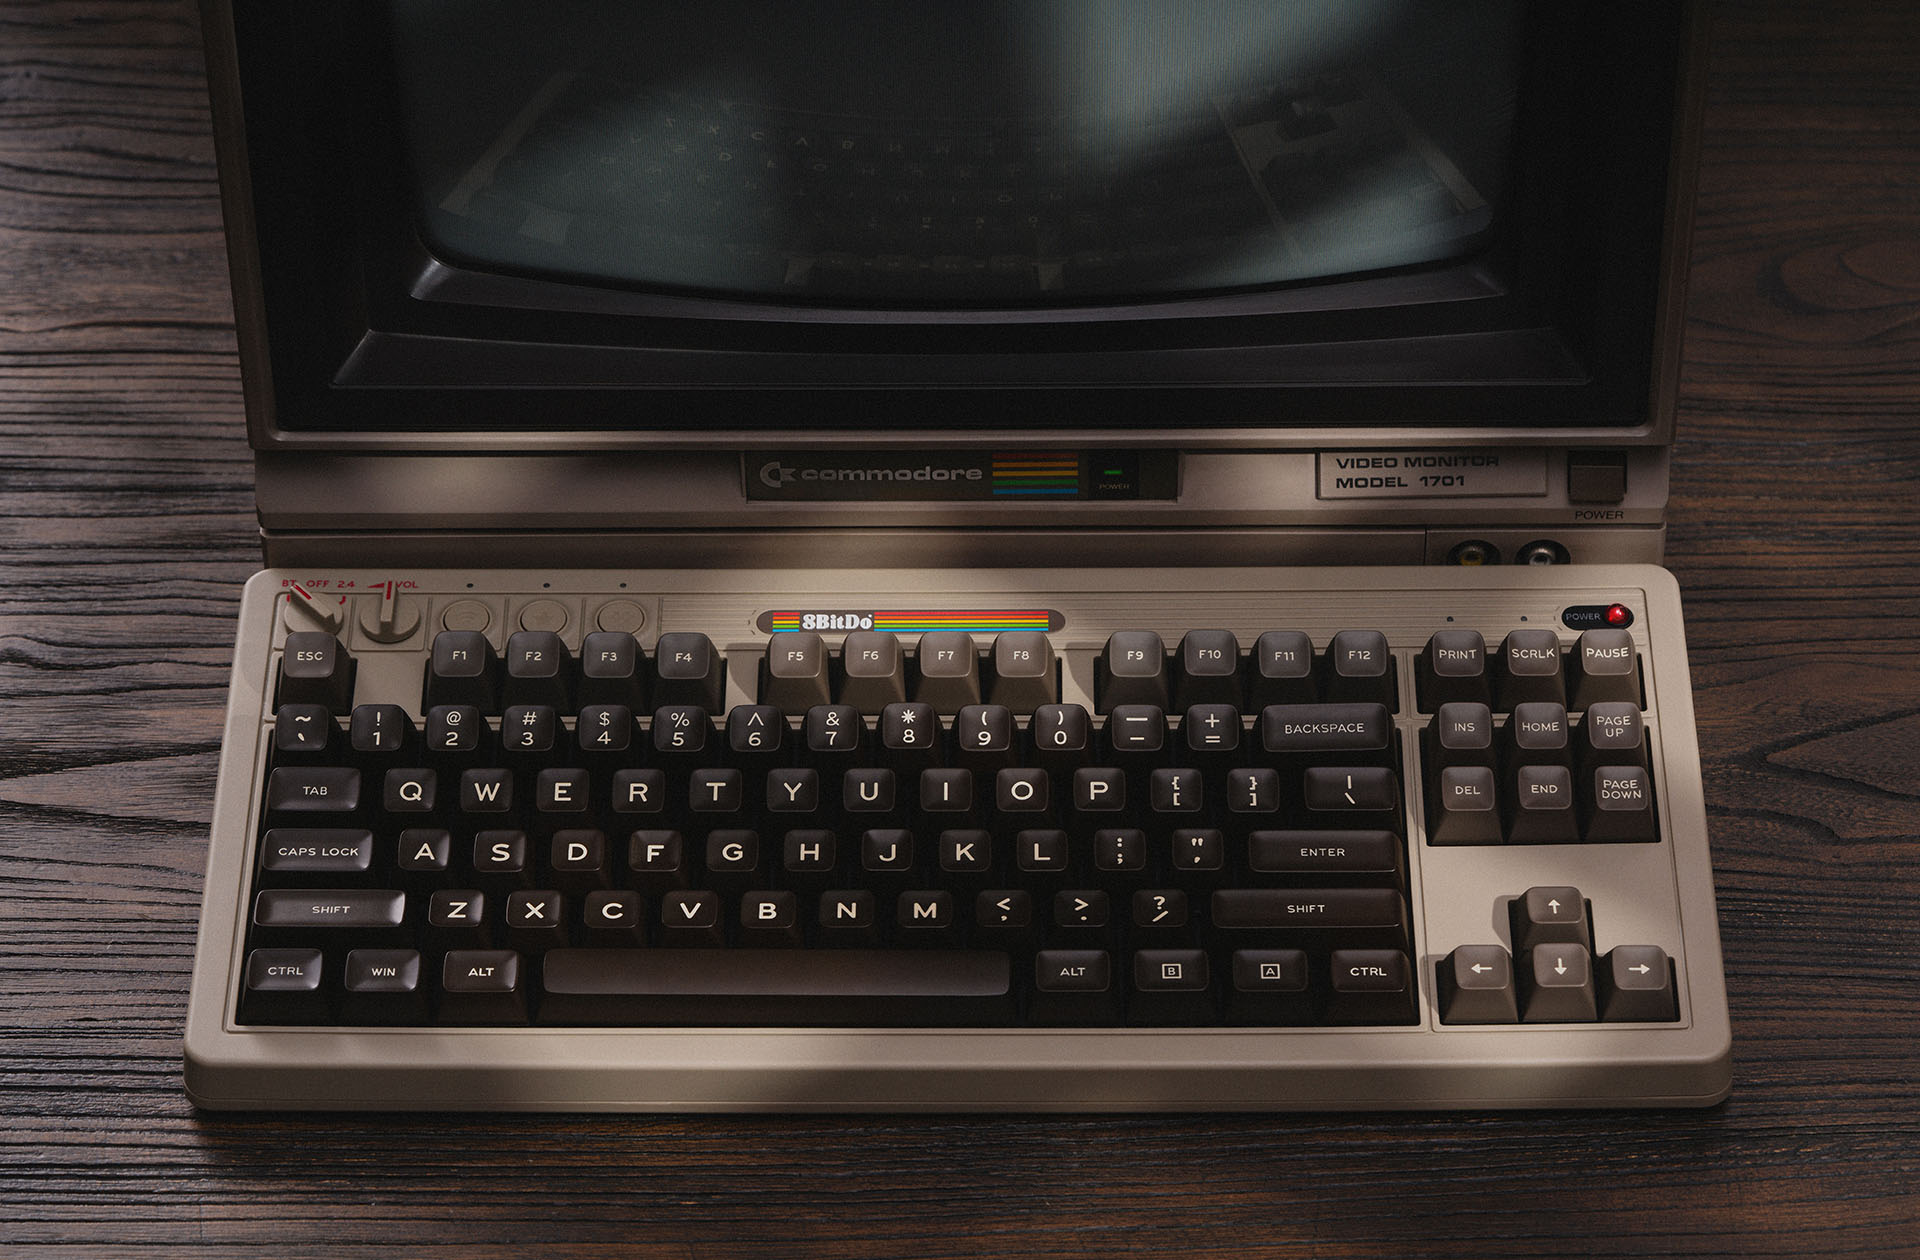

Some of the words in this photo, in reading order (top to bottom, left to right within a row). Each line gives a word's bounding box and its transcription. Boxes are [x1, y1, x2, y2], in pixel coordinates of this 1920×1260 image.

[1336, 458, 1398, 469] VIDEO
[1404, 455, 1499, 467] MONITOR
[801, 466, 983, 481] commodore
[1336, 477, 1408, 488] MODEL
[1419, 475, 1465, 487] 1701
[1575, 510, 1624, 521] POWER
[281, 579, 296, 588] BT
[306, 580, 329, 588] OFF
[337, 580, 355, 588] 2.4
[395, 581, 418, 589] VOL
[802, 614, 872, 630] 8BitDo
[1566, 612, 1600, 622] POWER
[297, 651, 323, 661] ESC
[452, 650, 467, 661] F1
[525, 651, 542, 661] F2
[601, 651, 618, 662] F3
[675, 652, 693, 663] F4
[787, 651, 804, 662] F5
[863, 650, 879, 661] F6
[938, 650, 954, 661] F7
[1013, 650, 1030, 661] F8
[1127, 650, 1144, 661] F9
[1199, 649, 1222, 659] F10
[1274, 651, 1295, 661] F11
[1348, 650, 1371, 660] F12
[1438, 649, 1477, 660] PRINT
[1511, 648, 1555, 659] SCRLK
[1586, 646, 1629, 658] PAUSE
[375, 711, 382, 727] !
[446, 710, 462, 726] @
[522, 711, 537, 726] #
[599, 711, 610, 727] $
[670, 712, 690, 728] %
[826, 711, 840, 726] &
[981, 711, 988, 726] (
[1057, 710, 1064, 726] )
[1204, 713, 1220, 728] +
[1596, 715, 1632, 727] PAGE
[1284, 722, 1365, 735] BACKSPACE
[1454, 722, 1475, 732] INS
[1521, 721, 1560, 732] HOME
[1604, 726, 1625, 738] UP
[372, 731, 381, 746] 1
[445, 731, 458, 746] 2
[521, 731, 534, 746] 3
[597, 730, 612, 745] 4
[671, 732, 685, 747] 5
[748, 732, 762, 747] 6
[825, 731, 838, 746] 7
[902, 728, 916, 744] 8
[977, 731, 992, 746] 9
[1054, 730, 1067, 745] 0
[1011, 780, 1034, 801] O
[1171, 776, 1181, 791] {
[1248, 775, 1258, 791] }
[1455, 785, 1481, 795] DEL
[1531, 784, 1558, 794] END
[1602, 778, 1639, 790] PAGE
[302, 786, 328, 796] TAB
[399, 781, 423, 801] Q
[474, 782, 501, 802] W
[554, 782, 572, 802] E
[629, 783, 648, 802] R
[705, 782, 727, 802] T
[783, 782, 803, 802] Y
[860, 782, 879, 801] U
[1090, 781, 1109, 801] P
[1344, 792, 1356, 805] \
[1601, 789, 1643, 801] DOWN
[1173, 792, 1181, 806] [
[1248, 791, 1257, 807] ]
[278, 847, 317, 856] CAPS
[321, 847, 359, 857] LOCK
[414, 842, 435, 861] A
[490, 843, 510, 862] S
[567, 843, 588, 861] D
[646, 844, 665, 863] F
[722, 843, 744, 861] G
[799, 843, 820, 861] H
[878, 844, 897, 862] J
[955, 843, 975, 861] K
[1034, 843, 1051, 861] L
[1300, 848, 1345, 857] ENTER
[311, 905, 351, 914] SHIFT
[447, 902, 468, 919] Z
[524, 902, 545, 919] X
[679, 902, 702, 919] V
[836, 902, 857, 919] N
[913, 902, 937, 919] M
[996, 897, 1011, 911] <
[1074, 898, 1089, 911] >
[1152, 895, 1167, 911] ?
[1287, 904, 1325, 914] SHIFT
[601, 902, 624, 920] C
[758, 902, 777, 920] B
[1151, 909, 1169, 923] /
[267, 966, 304, 976] CTRL
[371, 967, 396, 977] WIN
[468, 967, 495, 977] ALT
[1059, 967, 1086, 976] ALT
[1349, 967, 1387, 977] CTRL
